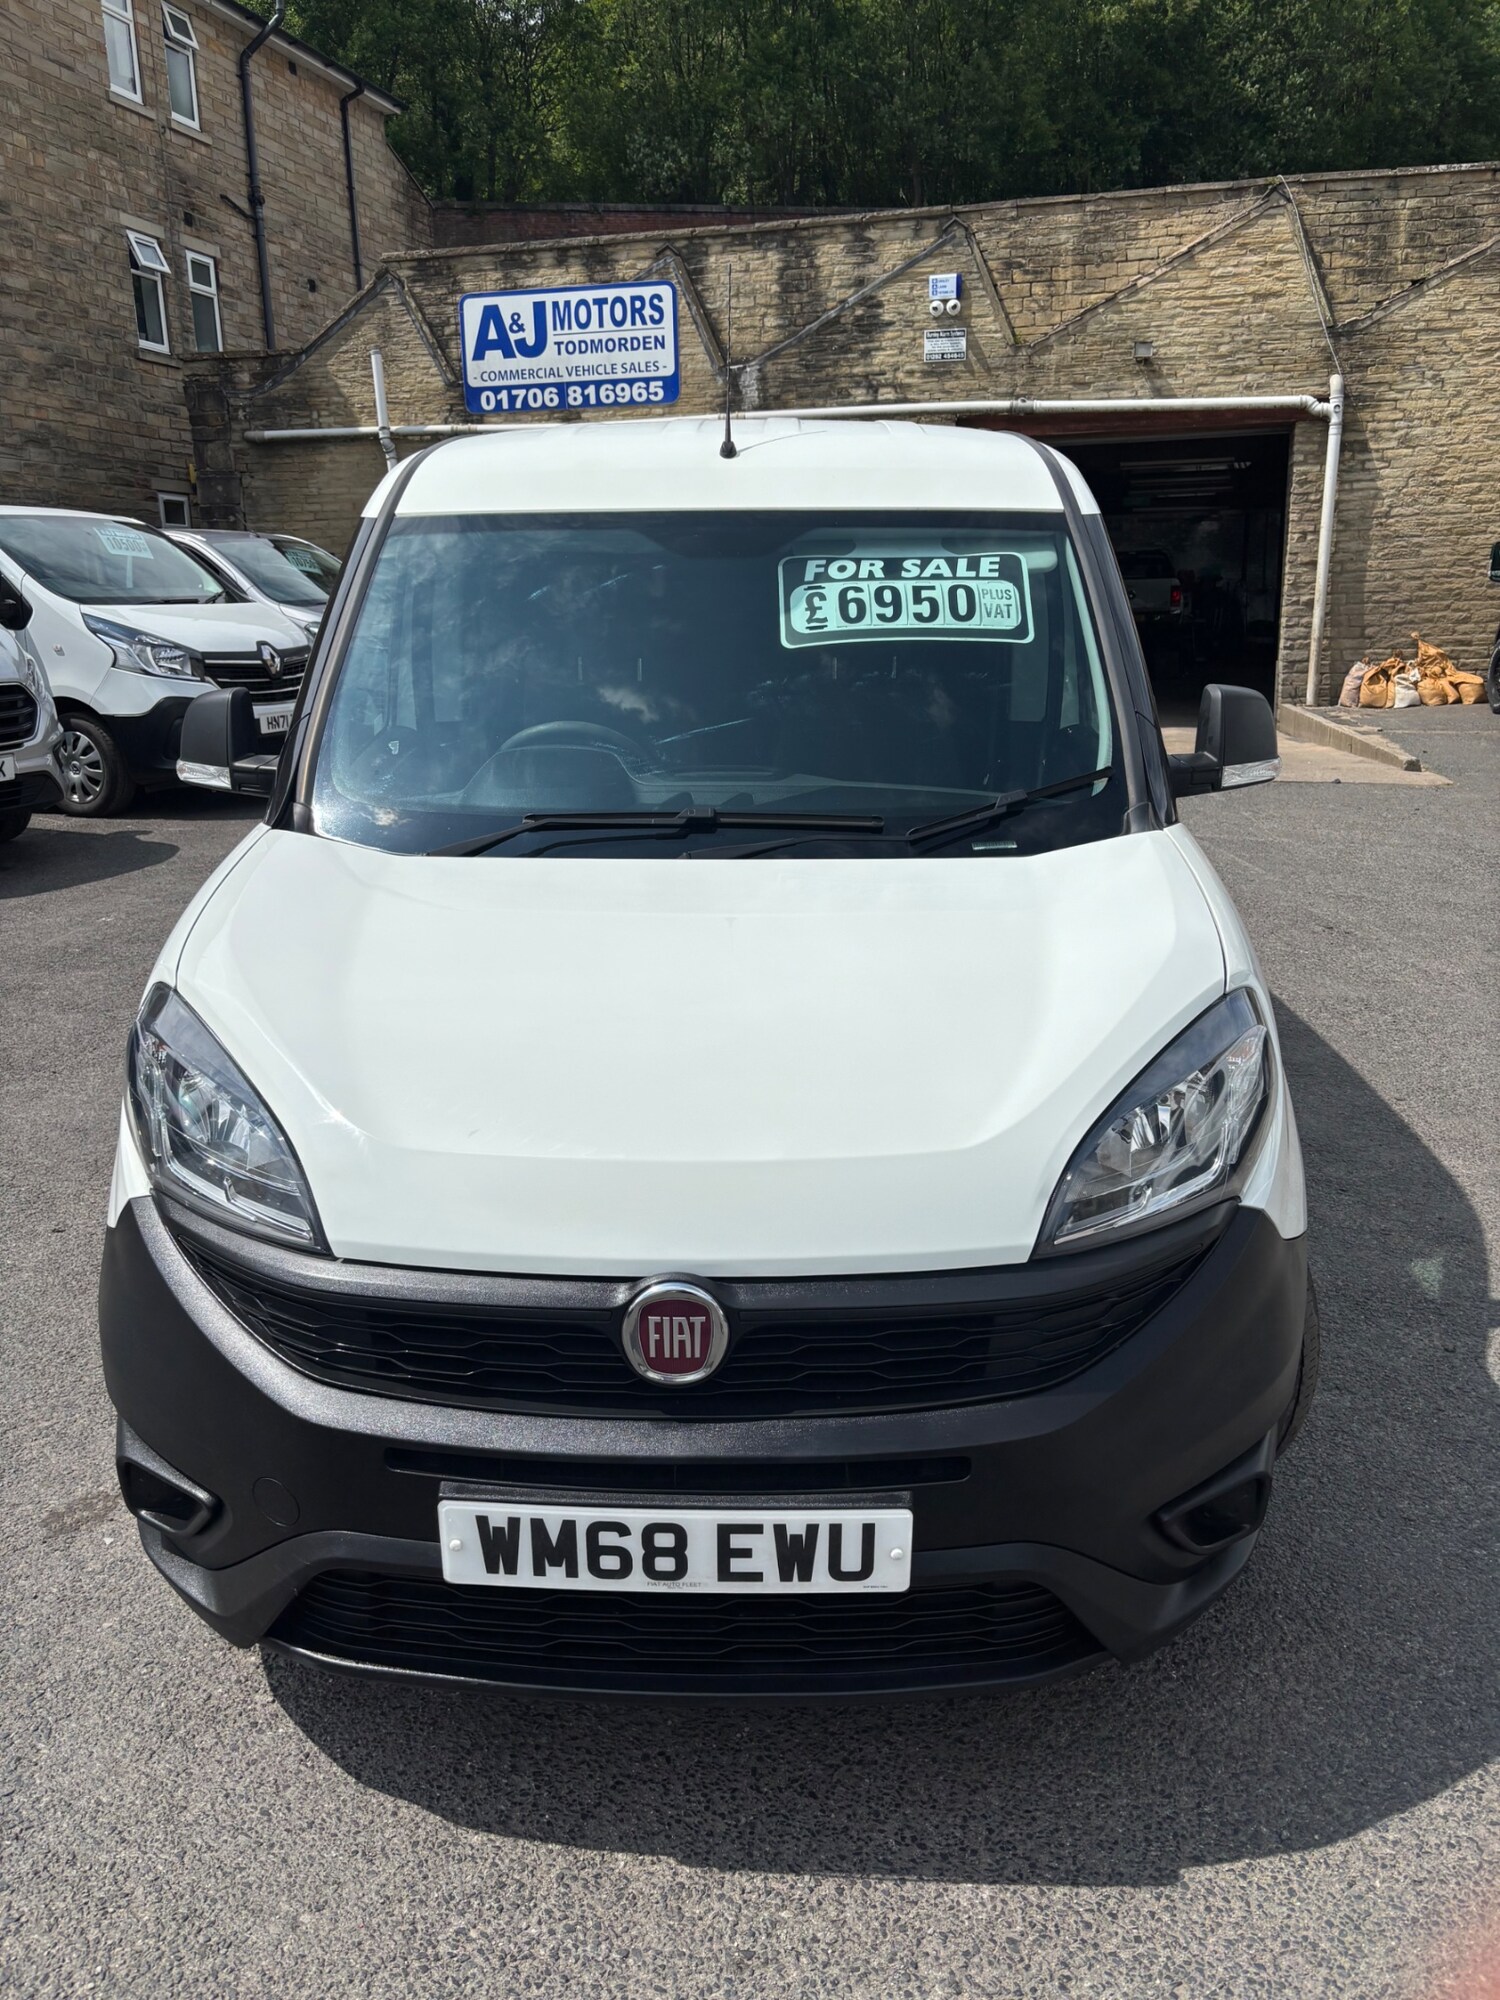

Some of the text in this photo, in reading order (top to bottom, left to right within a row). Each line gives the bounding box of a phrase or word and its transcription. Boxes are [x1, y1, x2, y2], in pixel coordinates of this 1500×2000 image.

[552, 293, 665, 331] MOTORS
[554, 335, 666, 356] TODMORDEN
[480, 360, 660, 383] COMMERCIAL VEHICLE SALES
[480, 381, 665, 411] 01706 816965
[804, 556, 1000, 582] FOR SALE
[981, 588, 1013, 601] PLUS
[983, 603, 1013, 619] VAT
[648, 1316, 706, 1358] FIAT
[475, 1514, 876, 1583] WM68 EWU
